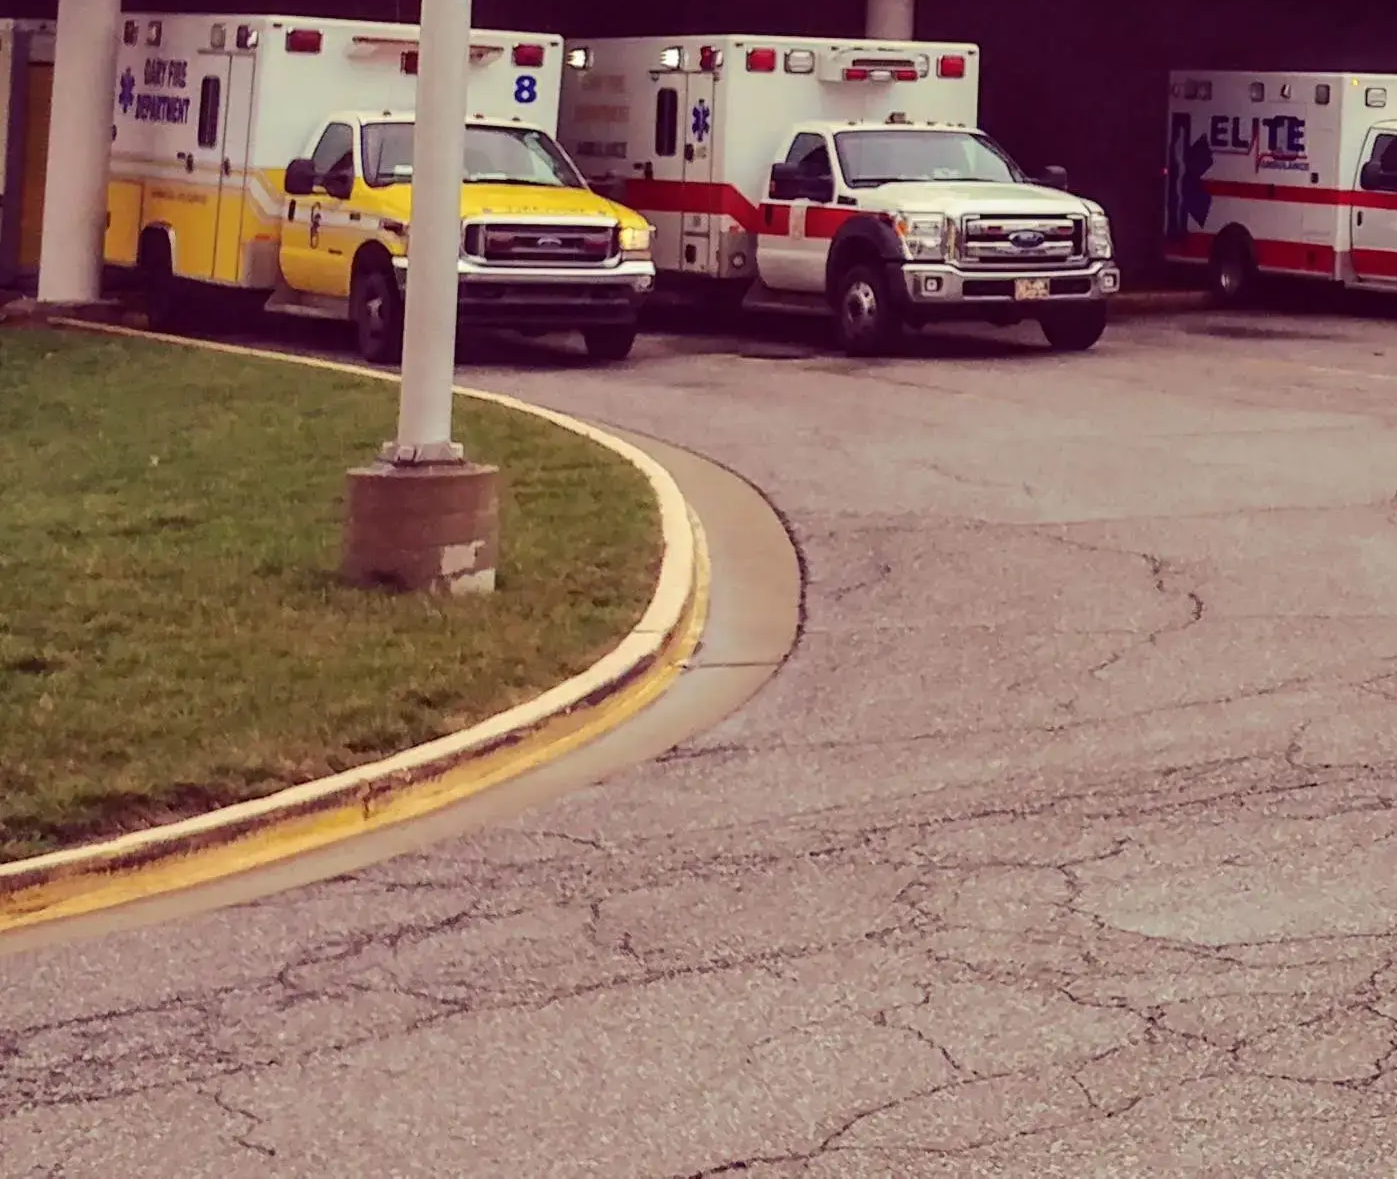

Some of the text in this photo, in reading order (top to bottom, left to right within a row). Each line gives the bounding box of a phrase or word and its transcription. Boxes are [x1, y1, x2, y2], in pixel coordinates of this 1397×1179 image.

[514, 74, 537, 103] 8
[134, 93, 191, 124] DEPARTMENT
[1210, 115, 1306, 153] ELITE
